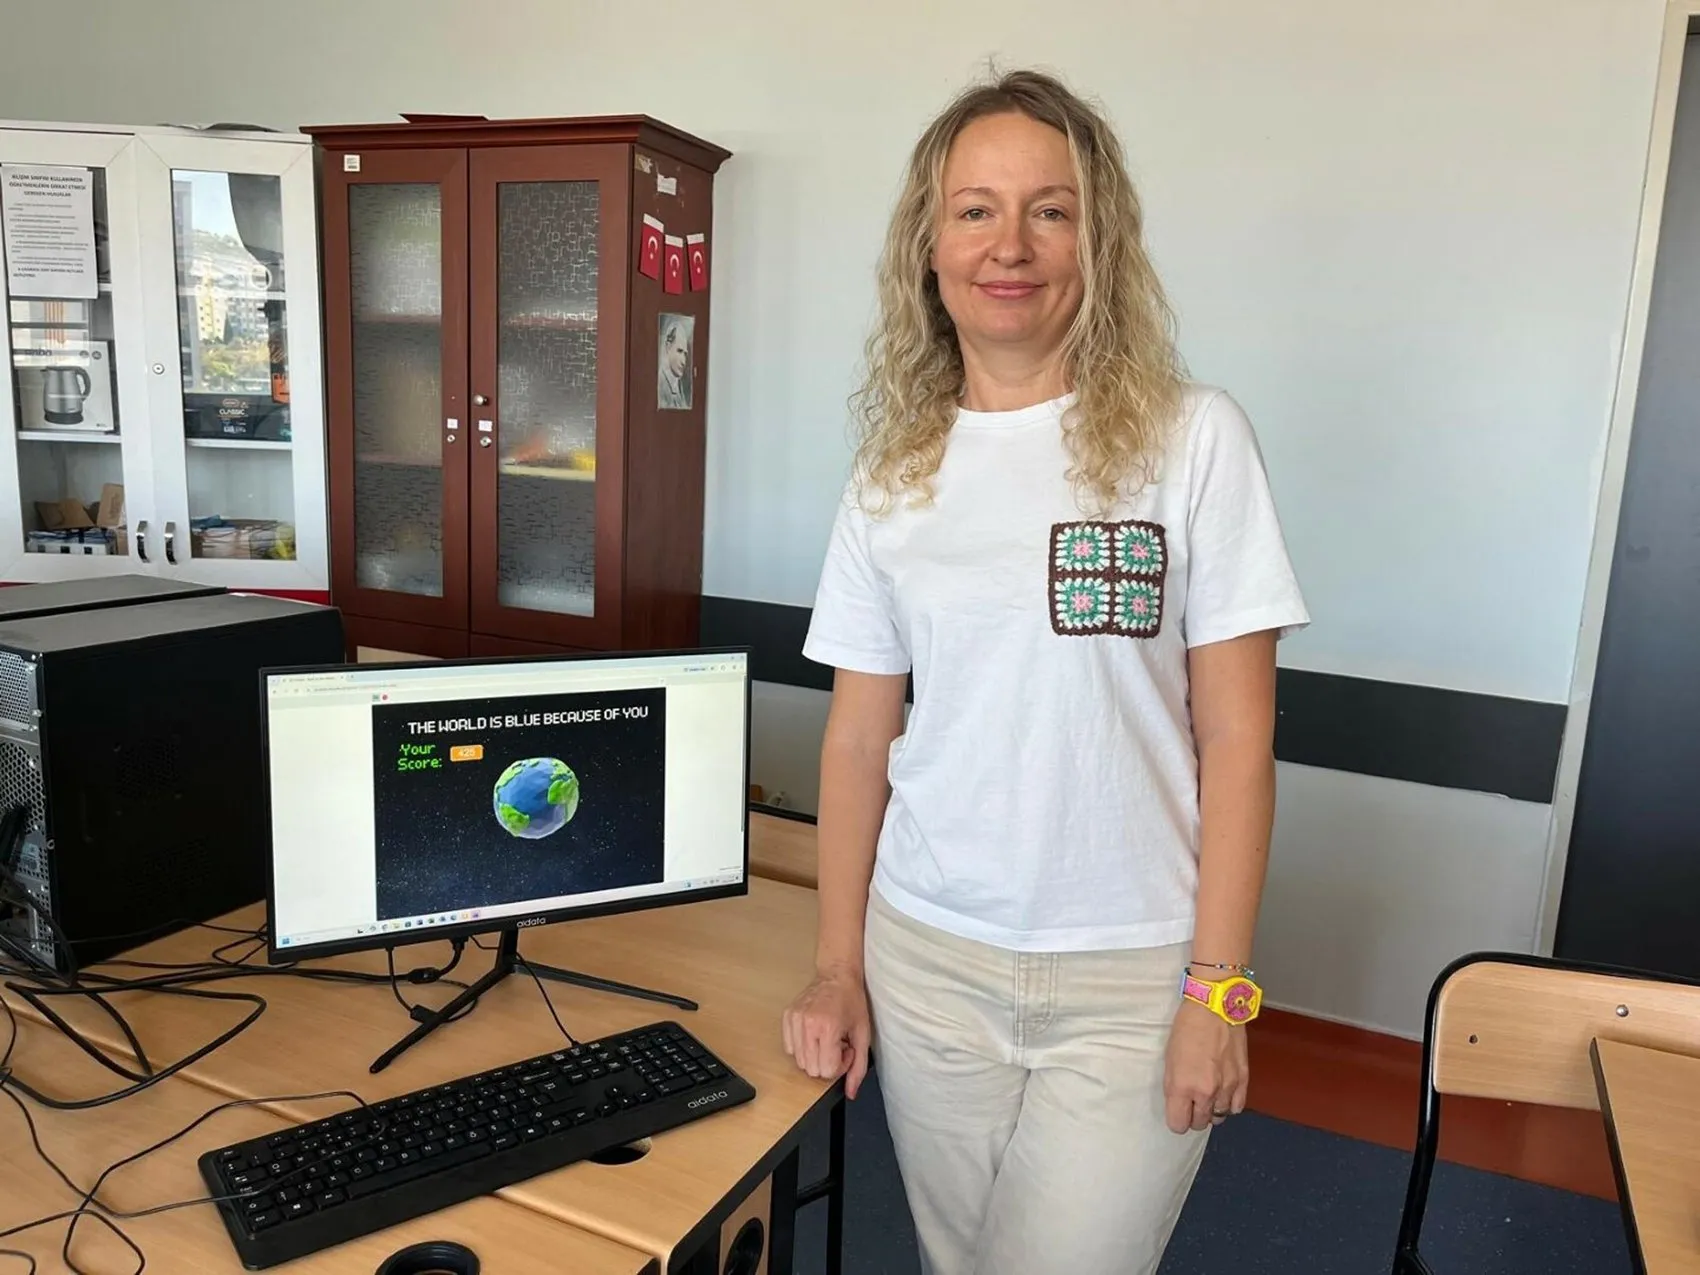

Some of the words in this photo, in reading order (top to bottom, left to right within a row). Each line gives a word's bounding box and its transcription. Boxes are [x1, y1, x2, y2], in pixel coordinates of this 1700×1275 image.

[407, 720, 437, 735] THE
[438, 717, 487, 732] WORLD
[489, 715, 503, 729] IS
[505, 713, 541, 728] BLUE
[543, 709, 602, 725] BECAUSE
[604, 707, 620, 720] OF
[622, 705, 649, 719] YOU
[400, 743, 436, 756] Your
[397, 757, 443, 771] Score:
[687, 1090, 728, 1109] aidata
